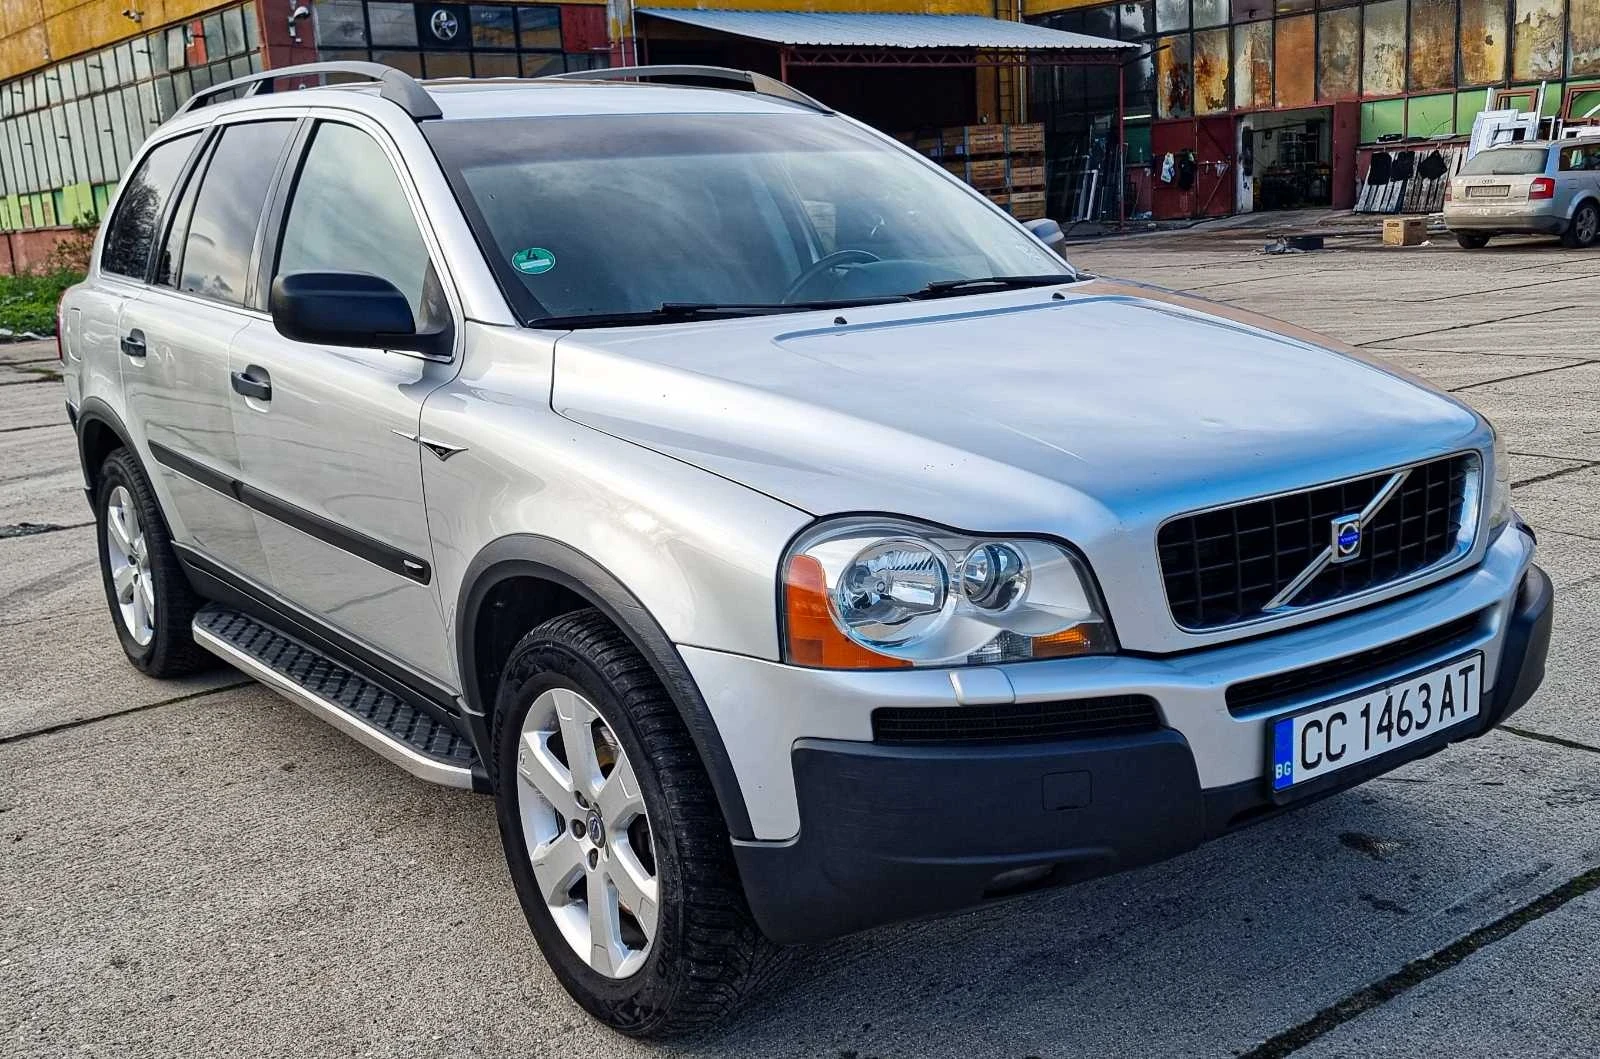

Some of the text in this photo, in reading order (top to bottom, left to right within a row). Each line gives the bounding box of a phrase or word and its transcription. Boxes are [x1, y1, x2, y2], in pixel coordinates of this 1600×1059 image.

[1301, 664, 1476, 770] CC 1463 AT
[1275, 761, 1292, 779] BG
